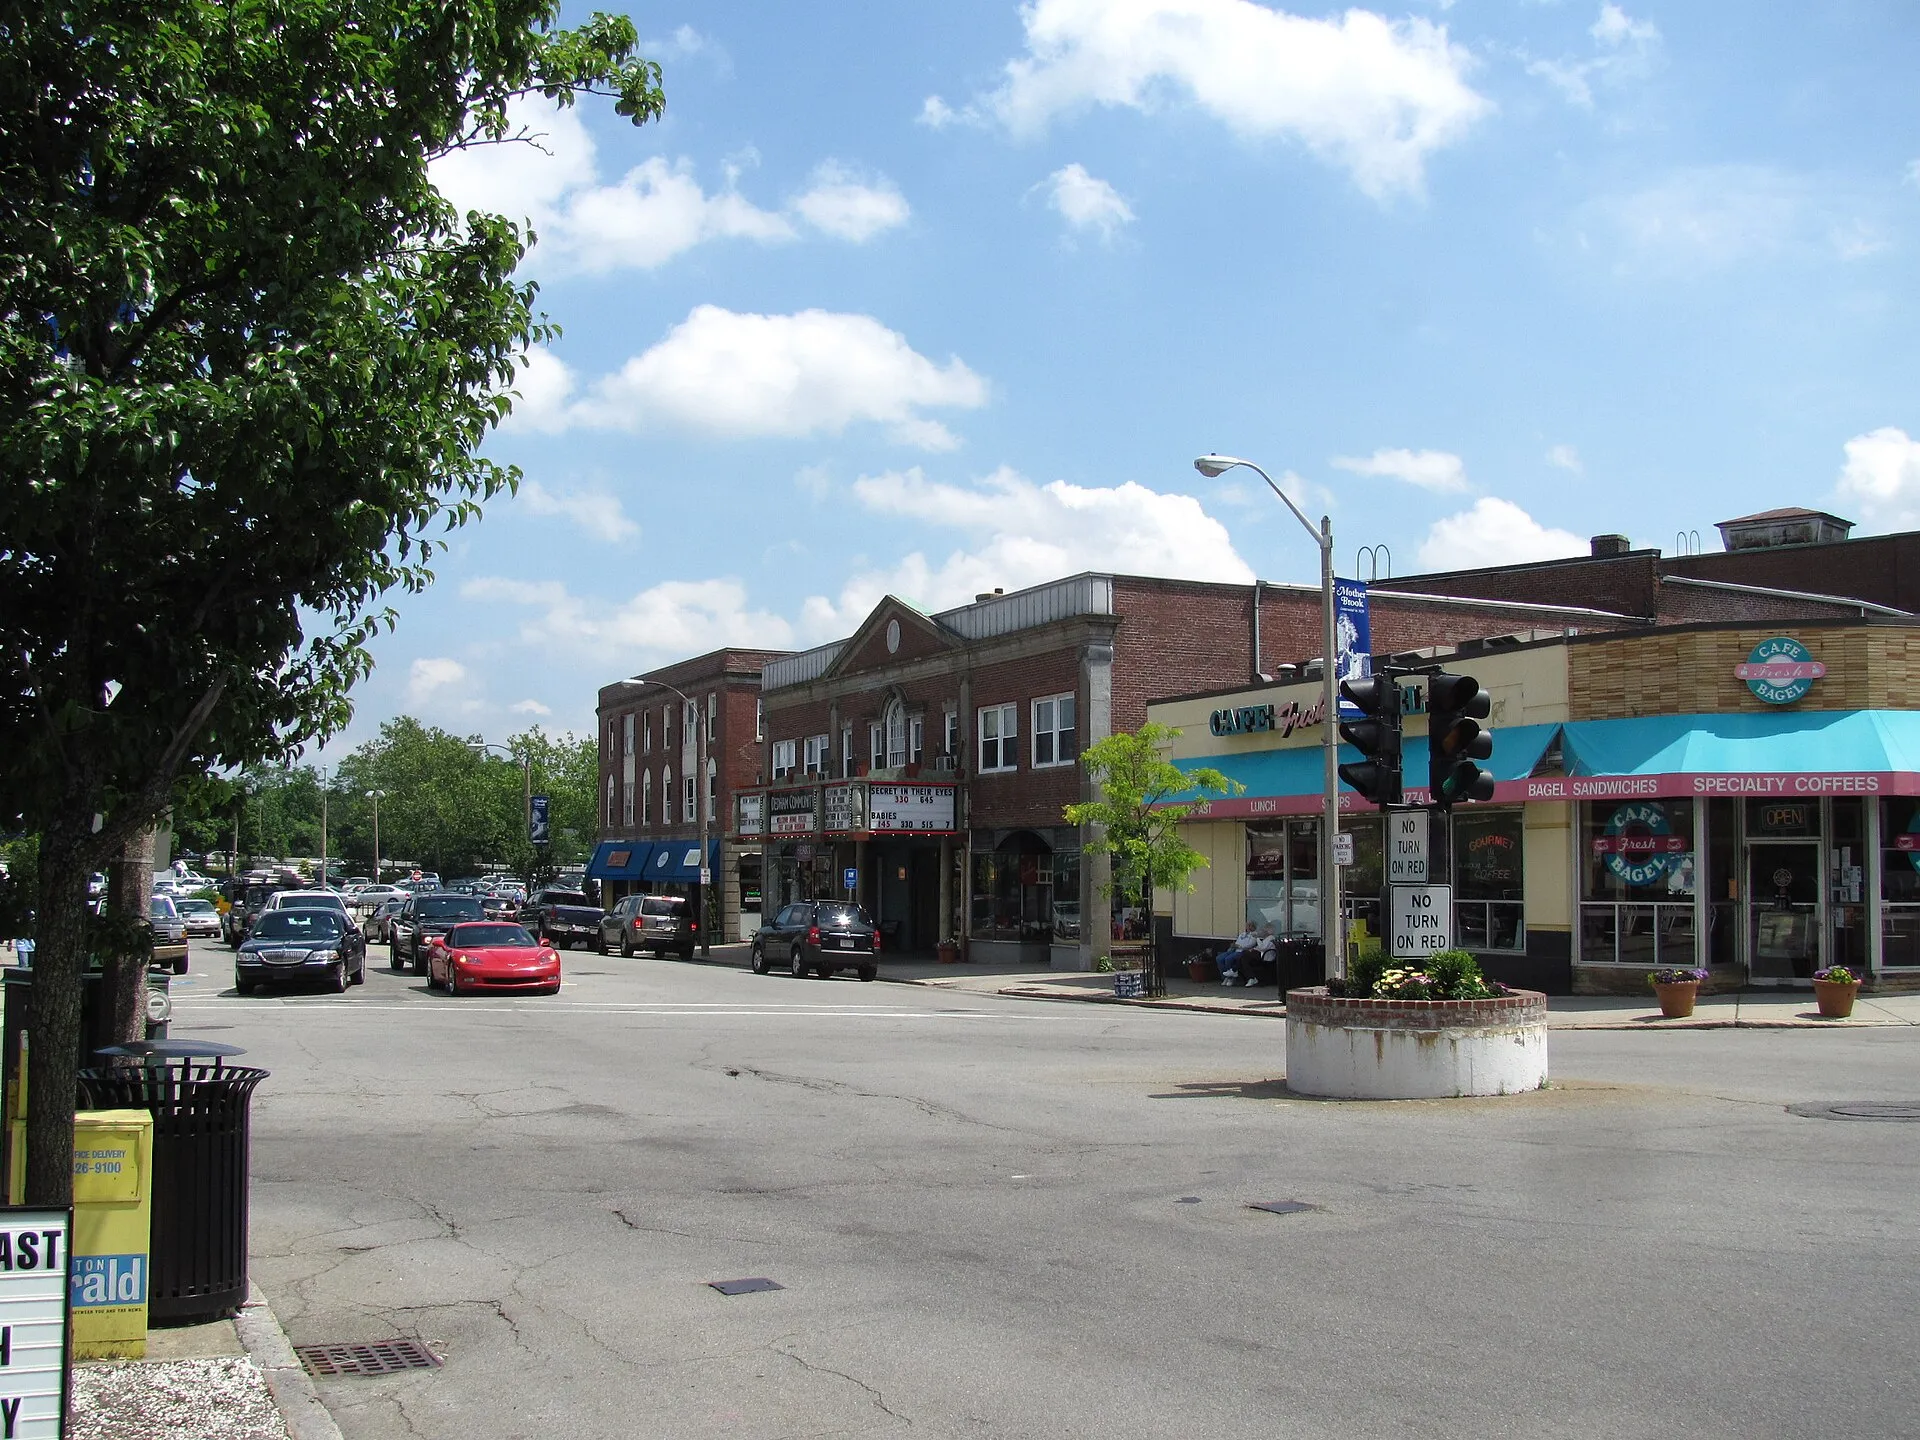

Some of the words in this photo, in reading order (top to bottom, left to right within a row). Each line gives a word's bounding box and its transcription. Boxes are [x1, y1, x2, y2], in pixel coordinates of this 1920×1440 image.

[1336, 586, 1366, 599] Mother
[1340, 596, 1364, 608] Brook
[1758, 642, 1801, 658] CAFE
[1753, 665, 1802, 677] Fresh
[1756, 684, 1804, 701] BAGEL
[1209, 703, 1272, 737] CAFE
[871, 787, 898, 795] SECRET
[911, 788, 932, 796] THEIR
[935, 788, 953, 796] EYES
[1528, 783, 1568, 797] BAGEL
[1572, 779, 1657, 796] SANDWICHES
[1693, 776, 1787, 793] SPECIALTY
[1794, 776, 1880, 792] COFFEES
[895, 795, 909, 804] 330
[1250, 800, 1276, 813] LUNCH
[871, 811, 897, 820] BABIES
[1614, 808, 1661, 827] CAFE
[1766, 809, 1803, 826] OPEN
[900, 820, 914, 829] 330
[921, 820, 934, 829] 515
[945, 821, 950, 829] 7
[1402, 820, 1416, 833] NO
[1398, 840, 1420, 853] TURN
[1468, 833, 1516, 852] GOURMET
[1617, 837, 1657, 852] Fresh
[1392, 860, 1404, 874] ON
[1407, 860, 1425, 874] RED
[1610, 856, 1666, 882] BAGEL
[1474, 869, 1512, 880] COFFEE
[1411, 894, 1432, 908] NO
[1405, 914, 1439, 929] TURN
[1396, 935, 1414, 949] ON
[1421, 935, 1446, 949] RED
[92, 1149, 127, 1158] DELIVERY
